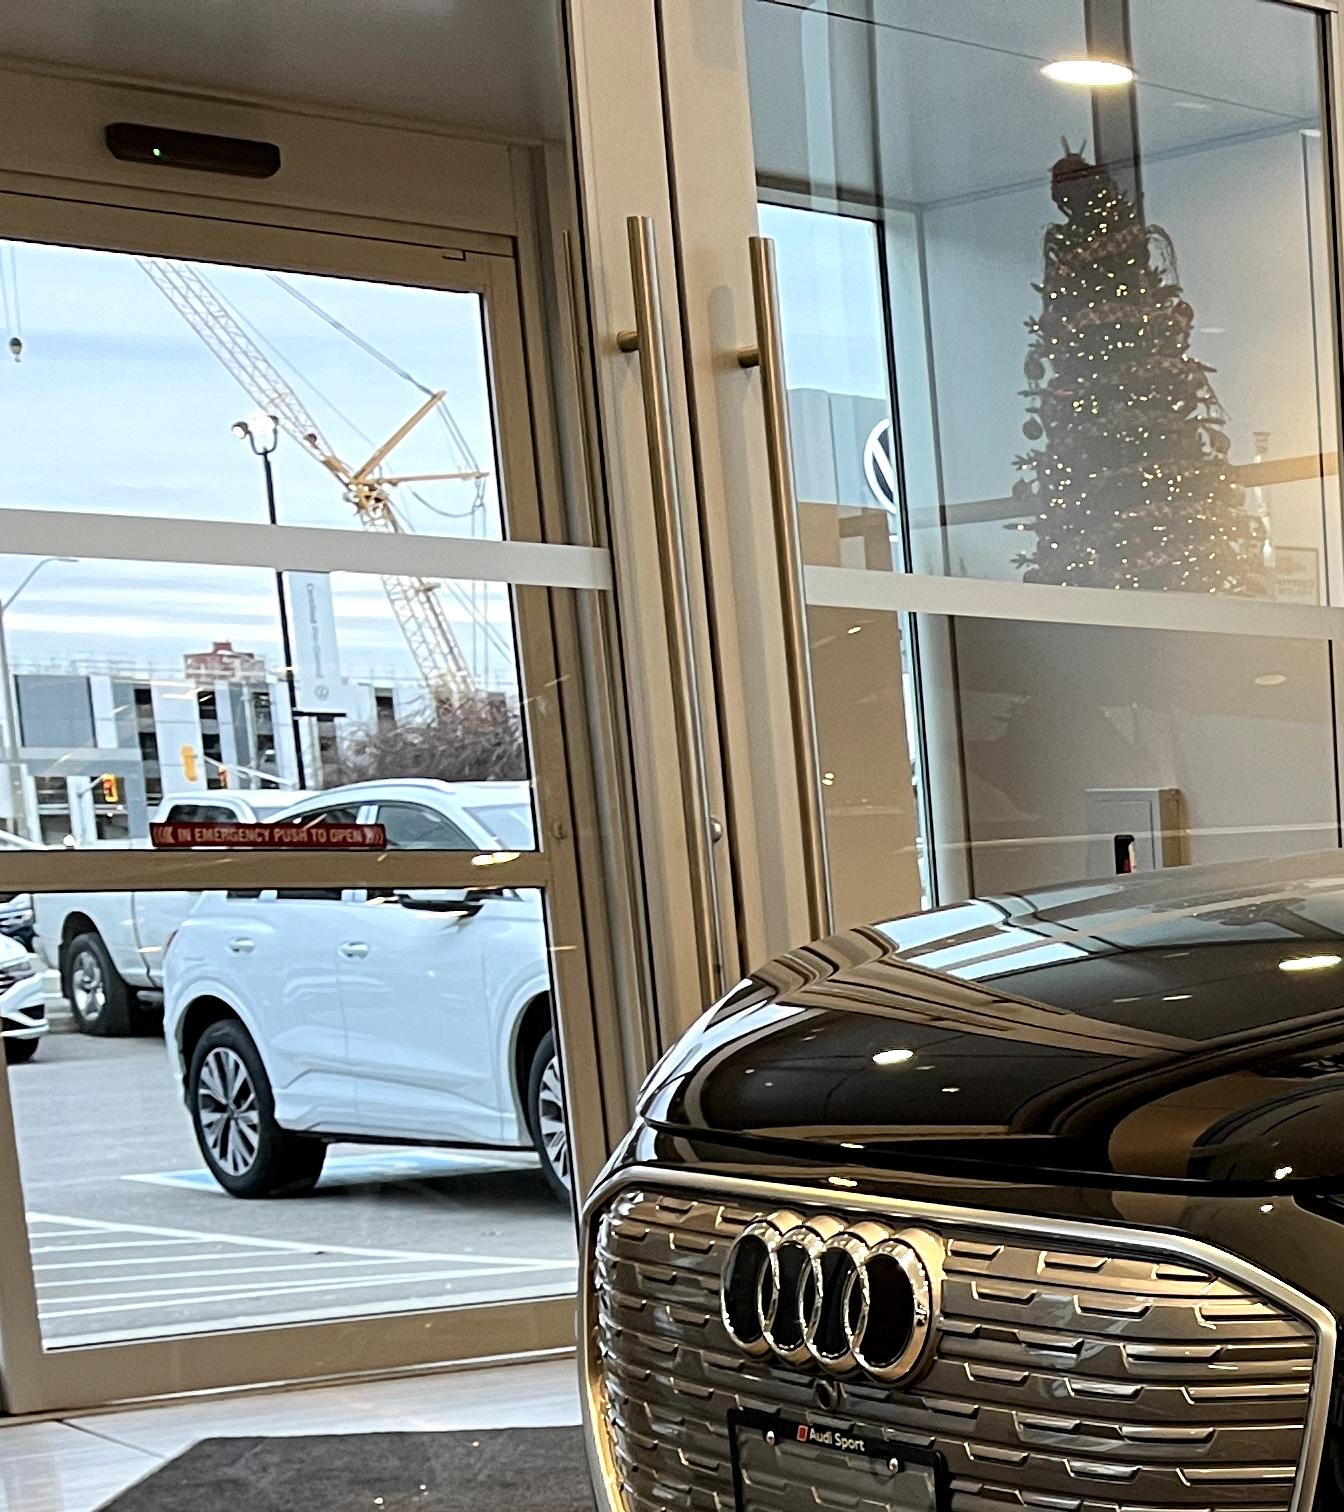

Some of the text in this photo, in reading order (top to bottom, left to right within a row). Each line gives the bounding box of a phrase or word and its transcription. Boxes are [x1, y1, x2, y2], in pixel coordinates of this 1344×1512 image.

[177, 827, 367, 843] IN EMERGENCY PUSH TO OPEN
[810, 1427, 865, 1453] Audi Sport
